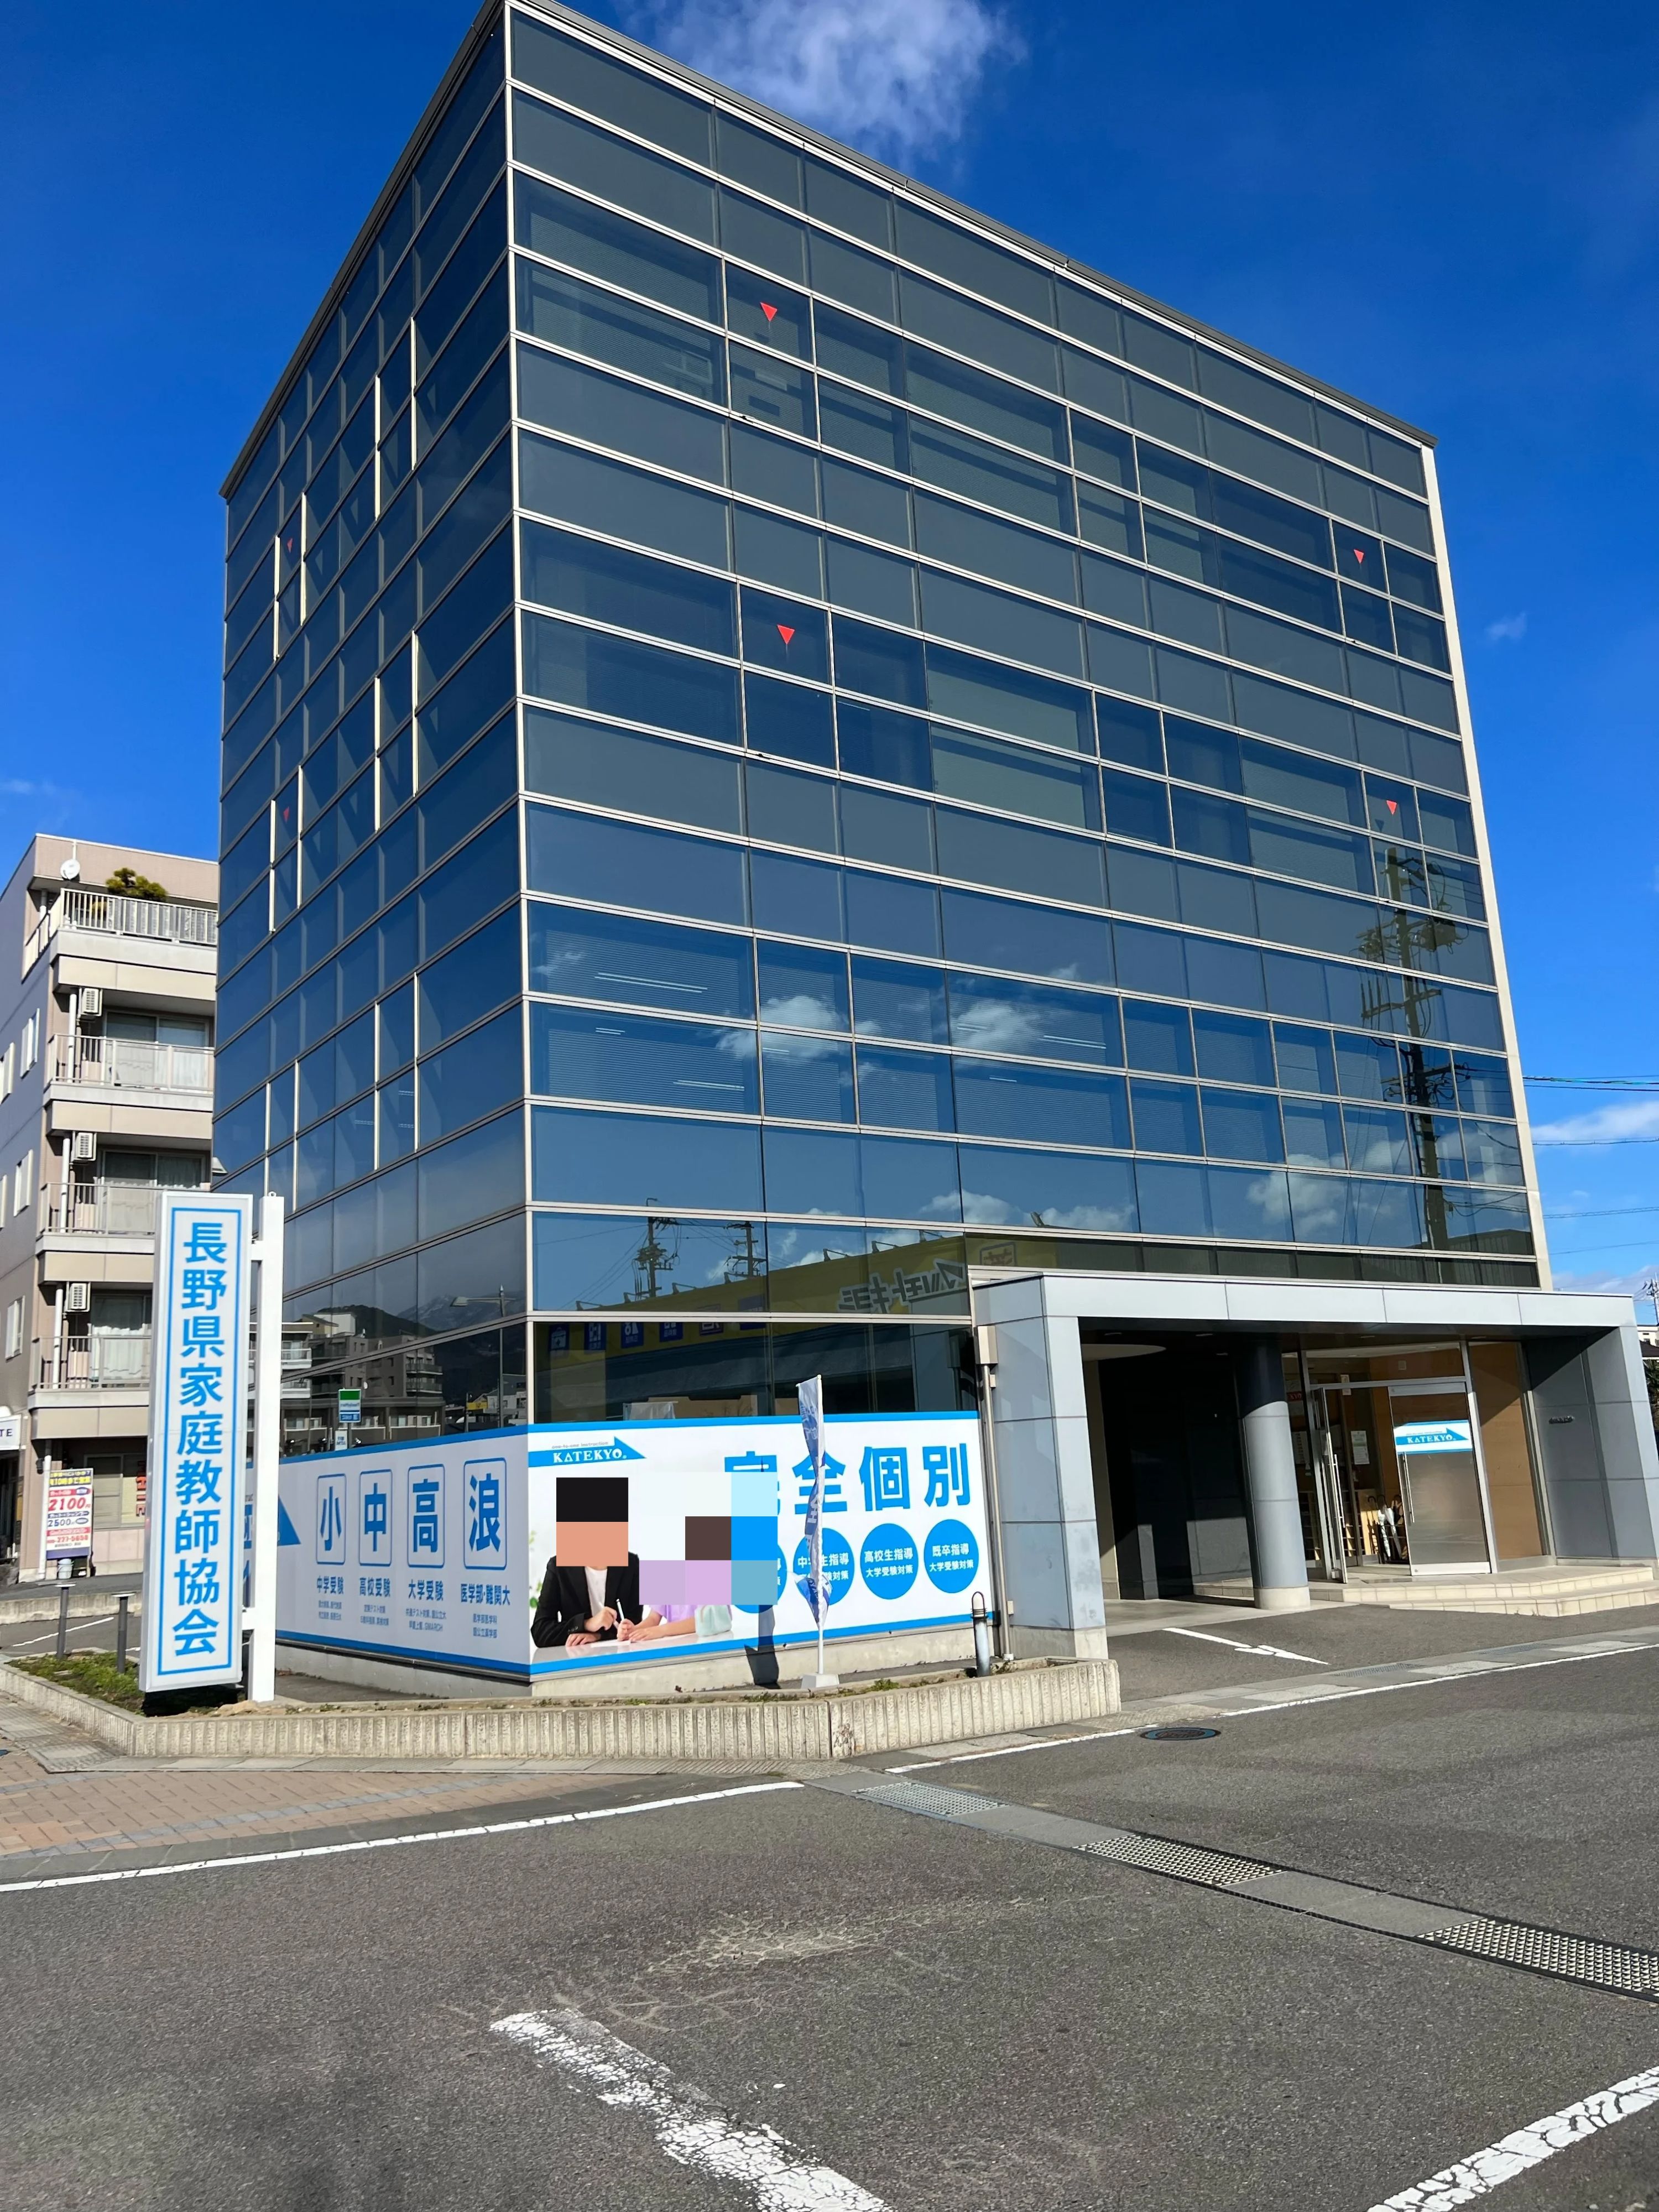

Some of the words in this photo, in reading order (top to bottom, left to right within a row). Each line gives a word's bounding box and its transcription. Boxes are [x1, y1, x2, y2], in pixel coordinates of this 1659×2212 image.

[172, 1222, 227, 1657] 長野県家庭教師協会
[724, 1442, 971, 1516] 全個別
[320, 1486, 342, 1551] 小
[364, 1483, 387, 1552] 中
[412, 1478, 440, 1553] 高
[469, 1473, 501, 1553] 浪
[864, 1547, 914, 1563] 高校生指導
[932, 1542, 969, 1557] 既卒指導
[797, 1552, 849, 1569] 中生指導
[929, 1559, 974, 1572] 大学受験対策
[865, 1564, 914, 1578] 大学受験対策
[316, 1575, 344, 1594] 中学受験
[359, 1577, 390, 1597] 高校受験
[408, 1579, 444, 1601] 大学受験
